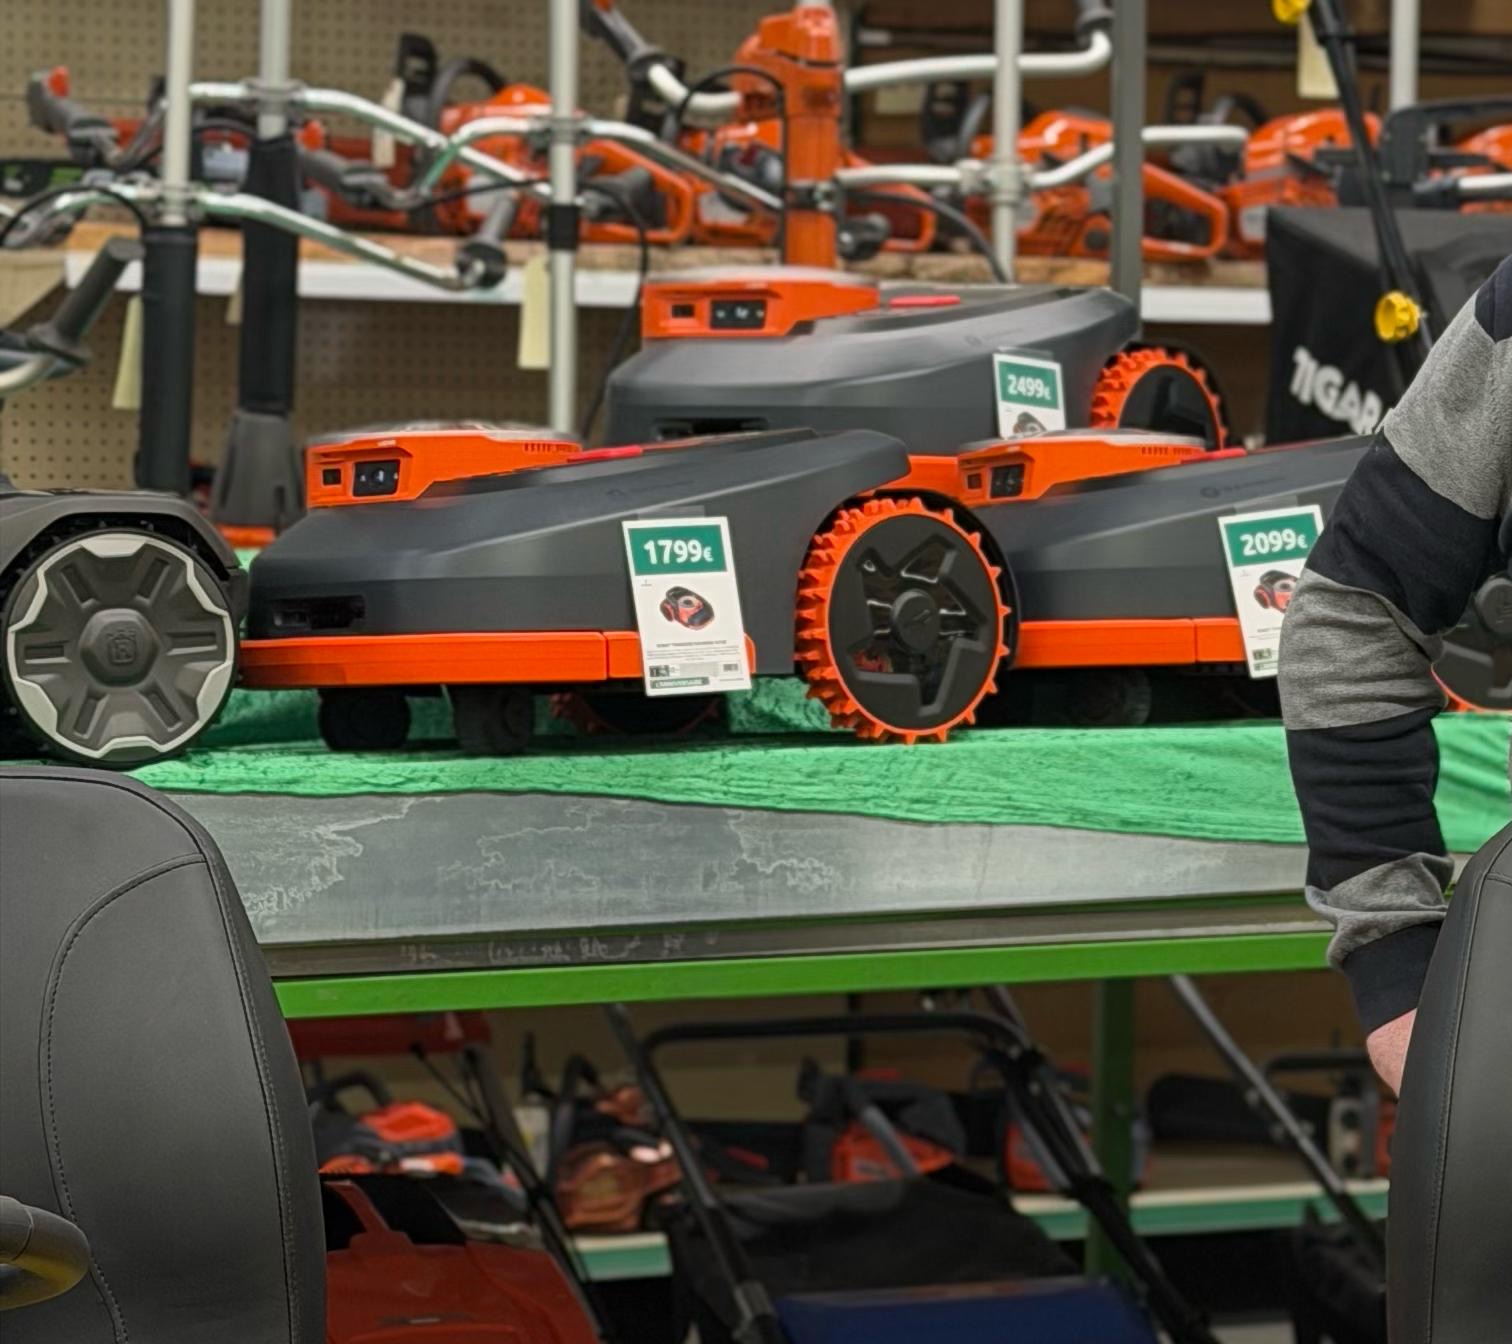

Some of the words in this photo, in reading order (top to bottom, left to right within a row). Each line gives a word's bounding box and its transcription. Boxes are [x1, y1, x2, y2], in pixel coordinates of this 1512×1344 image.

[1008, 374, 1051, 400] 2499€
[643, 539, 714, 565] 1799€
[1240, 528, 1308, 556] 2099€
